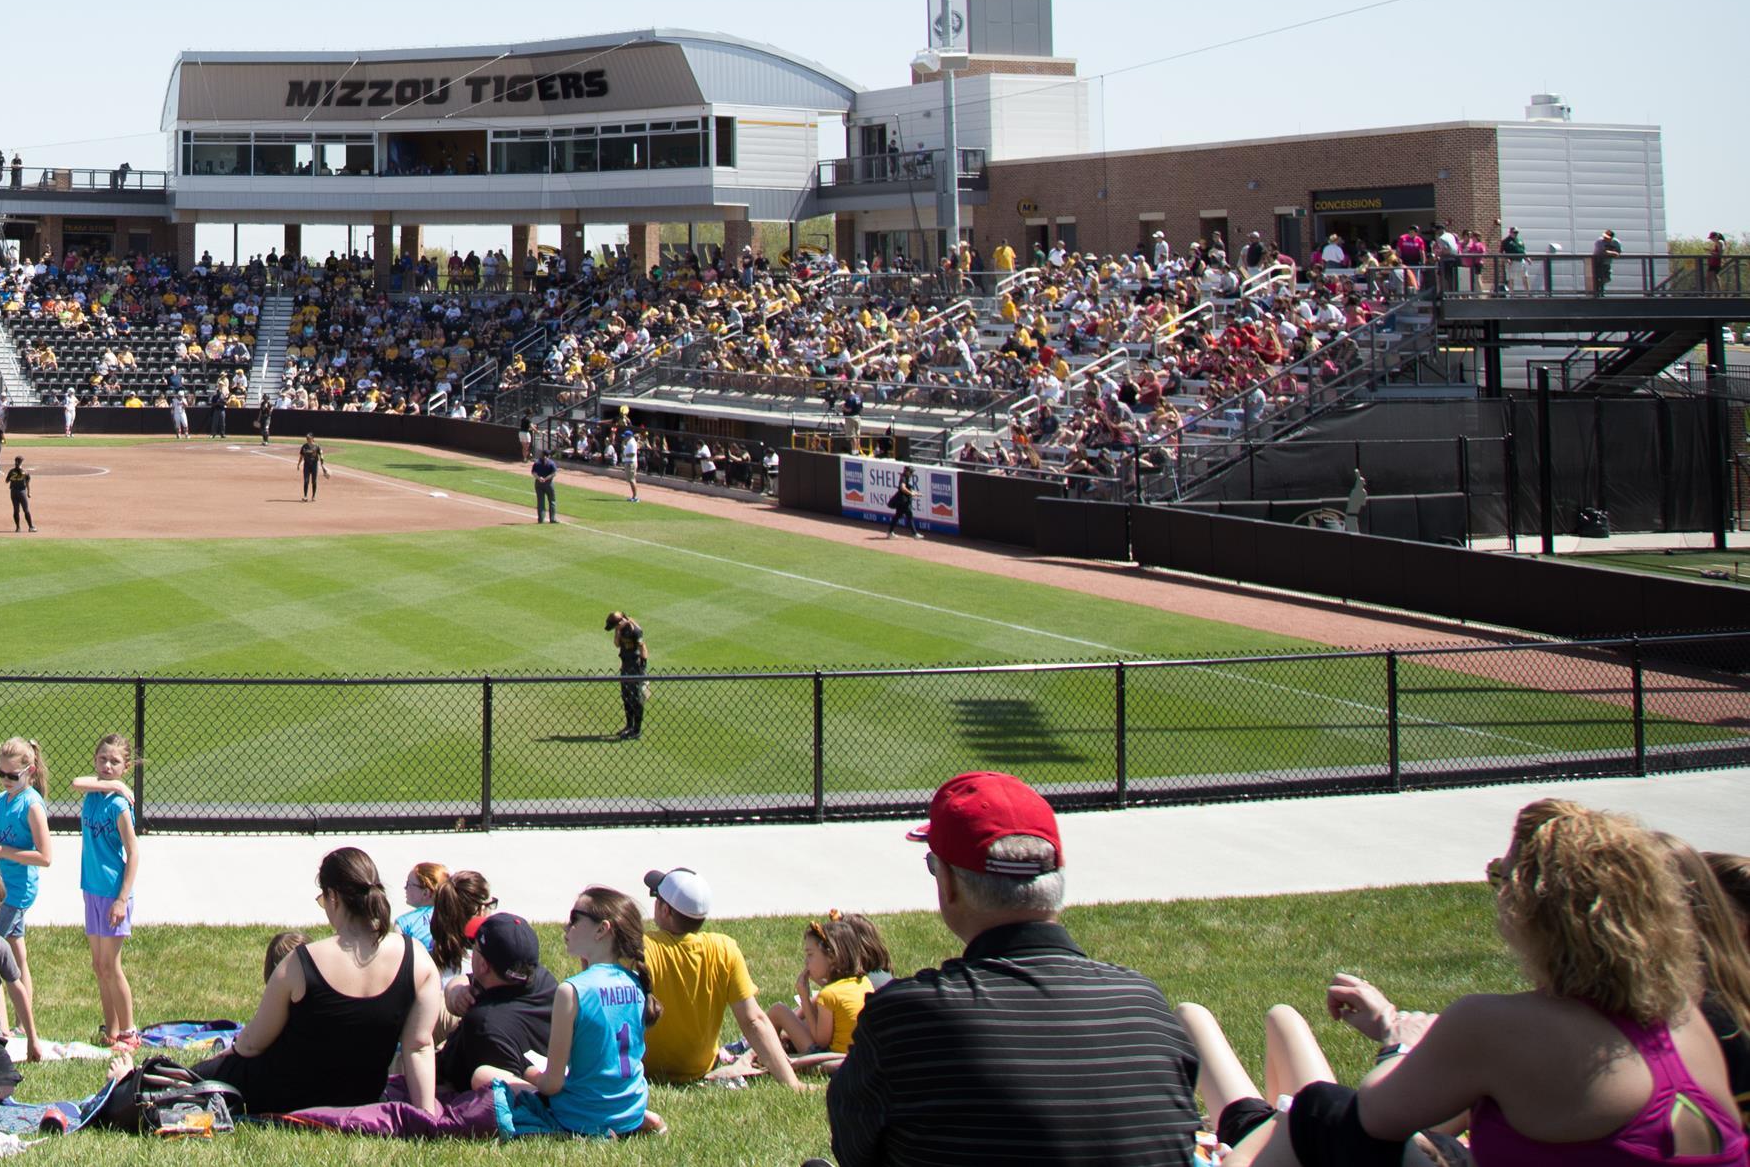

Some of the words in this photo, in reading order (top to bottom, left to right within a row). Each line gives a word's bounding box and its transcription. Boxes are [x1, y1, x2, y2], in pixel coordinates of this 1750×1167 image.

[285, 78, 449, 107] MIZZOU
[465, 69, 608, 103] TIGERS
[1315, 198, 1382, 210] CONCESSIONS
[870, 468, 919, 491] SHELR
[870, 492, 921, 511] INSUCE
[599, 986, 642, 1006] MADDIE
[616, 1022, 630, 1079] 1
